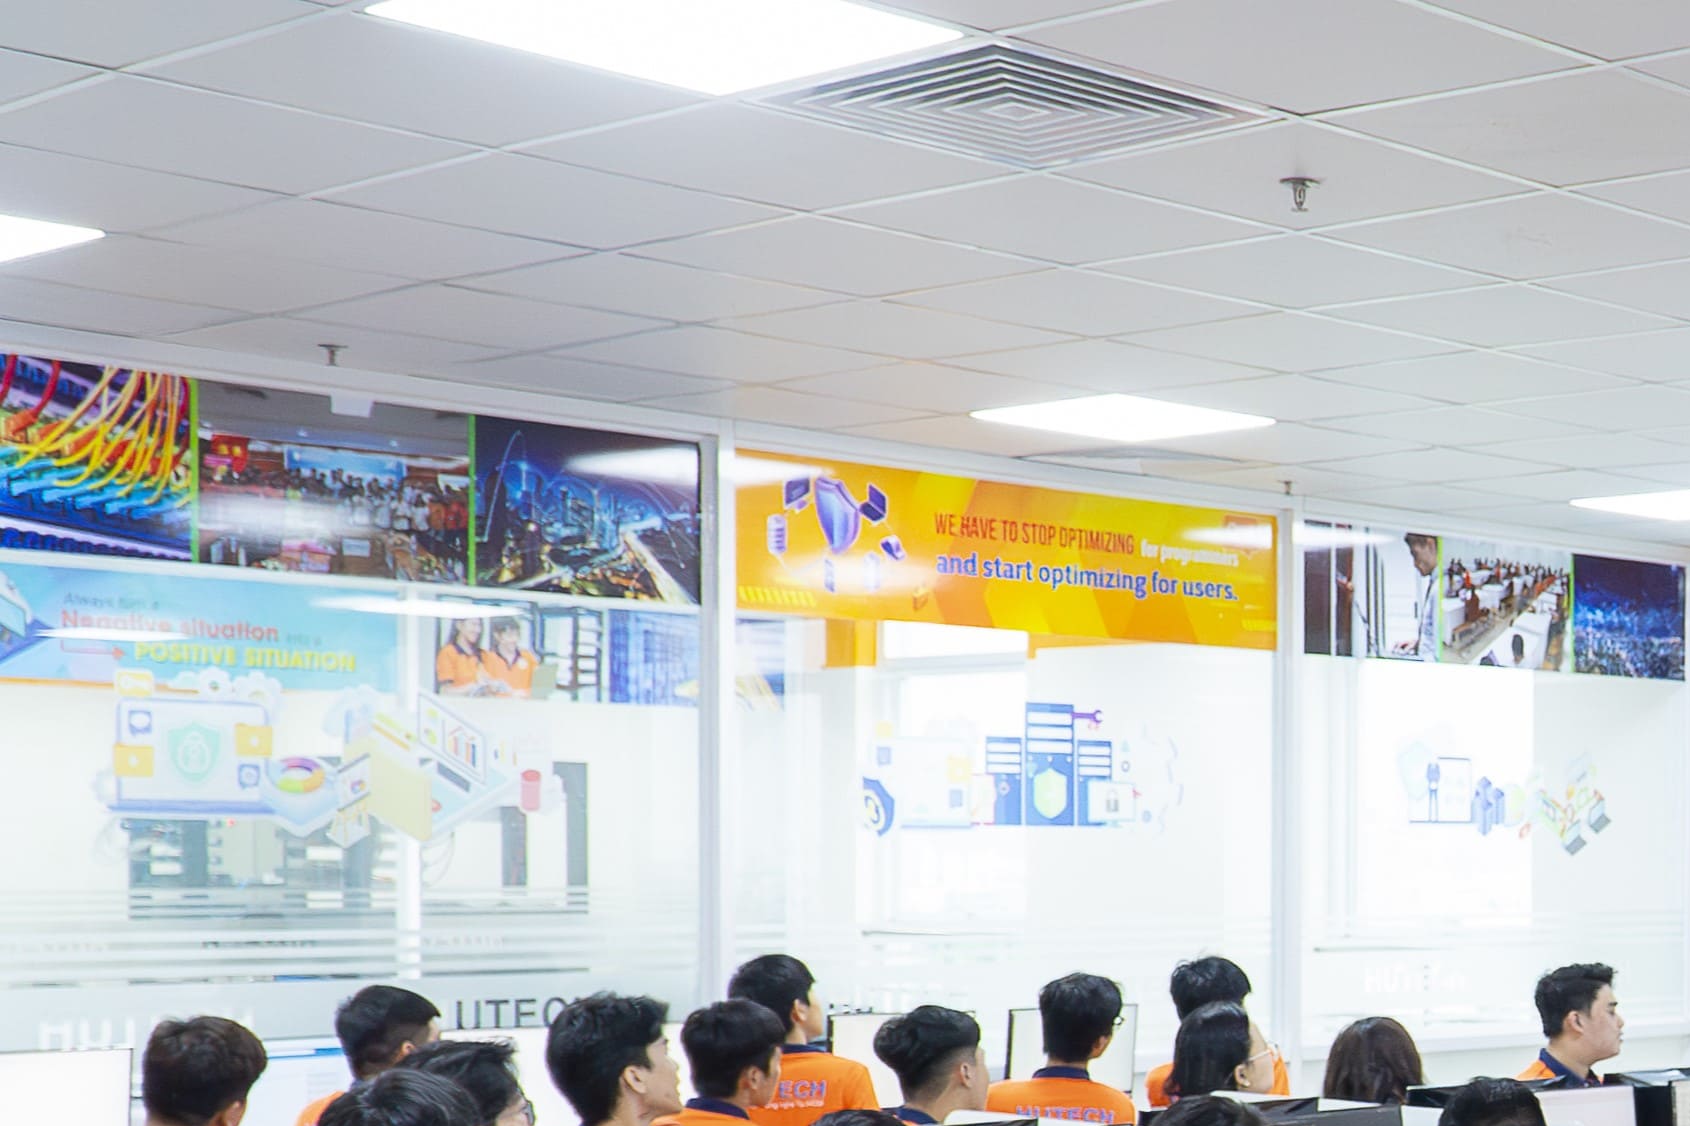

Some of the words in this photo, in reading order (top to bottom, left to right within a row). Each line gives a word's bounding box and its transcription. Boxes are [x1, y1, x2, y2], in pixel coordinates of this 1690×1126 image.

[935, 513, 955, 536] WE
[959, 515, 997, 541] HAVE
[1002, 520, 1018, 542] TO
[1021, 522, 1056, 546] STOP
[1059, 526, 1134, 555] OPTIMIZING
[936, 552, 978, 577] and
[983, 557, 1033, 582] start
[1038, 563, 1147, 599] optimizing
[1152, 570, 1179, 595] for
[1182, 580, 1239, 601] users.
[180, 616, 280, 643] situation
[134, 642, 237, 667] POSITIVE
[244, 647, 356, 673] SITUATION
[779, 1080, 826, 1099] ECH
